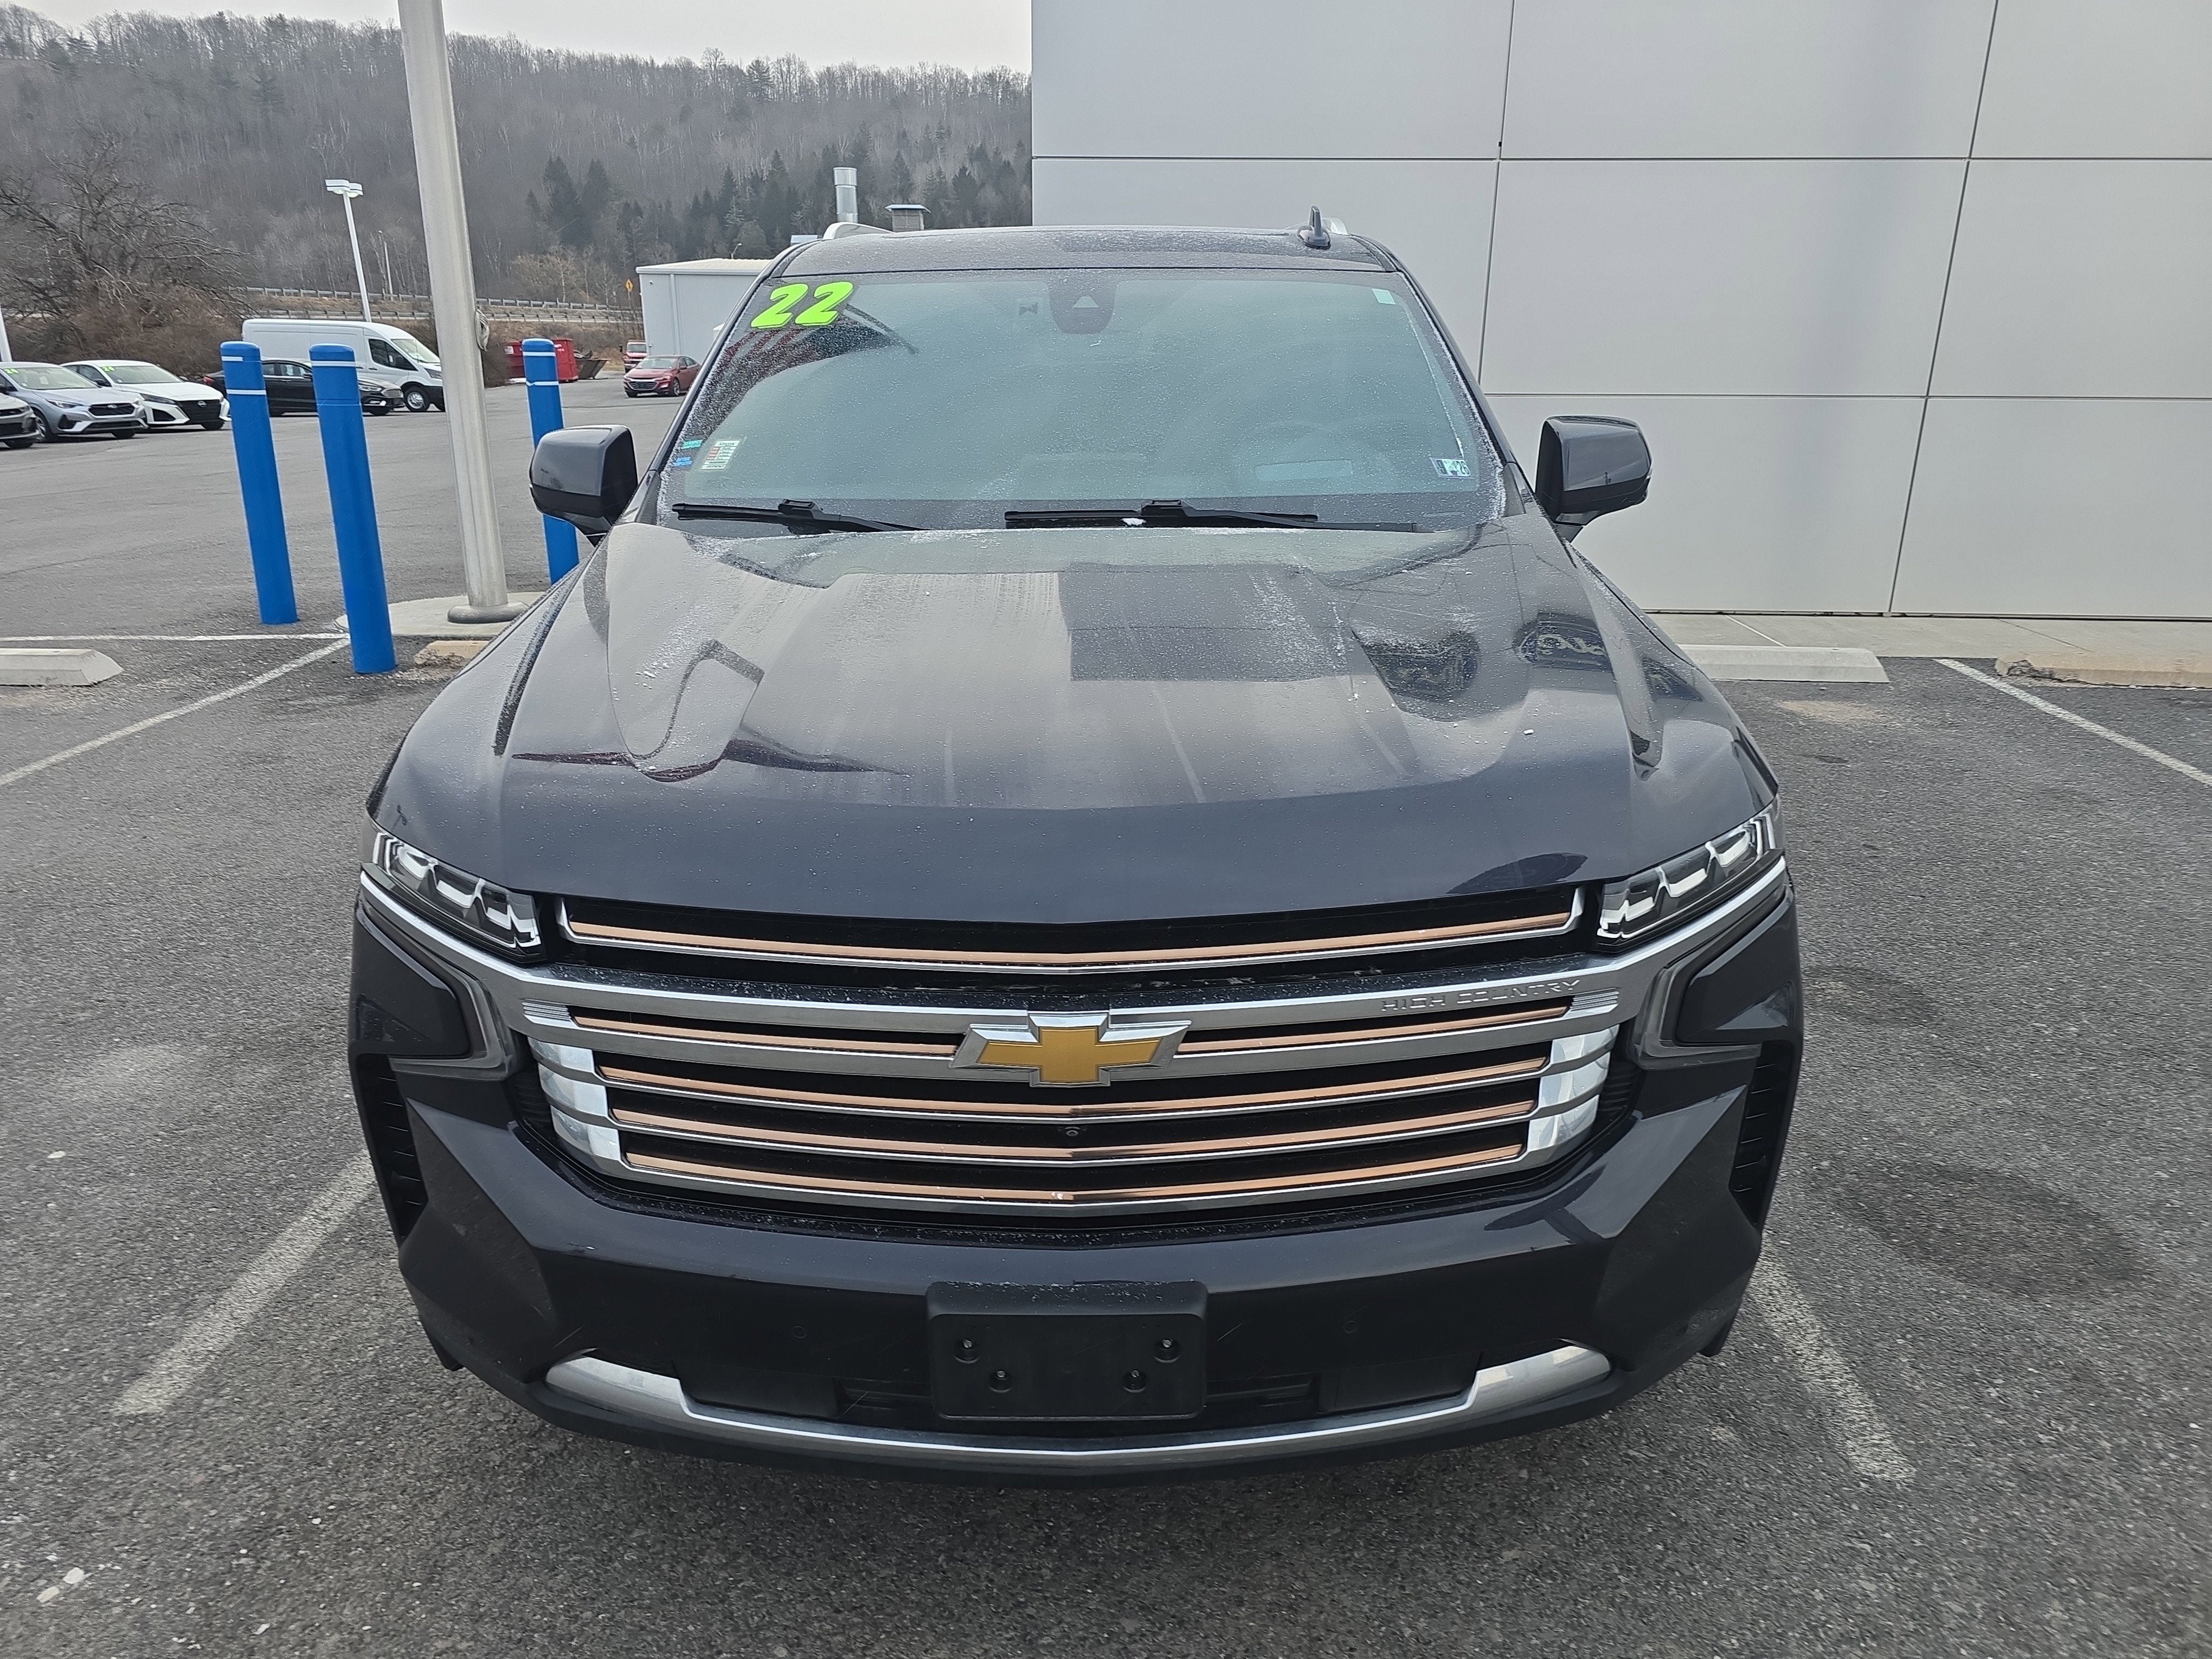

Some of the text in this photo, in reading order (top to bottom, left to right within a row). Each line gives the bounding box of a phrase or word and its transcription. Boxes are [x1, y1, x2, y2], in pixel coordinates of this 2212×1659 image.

[751, 281, 853, 329] 22
[1456, 460, 1470, 475] 26
[1380, 979, 1580, 1012] HIGH COUNTRY
